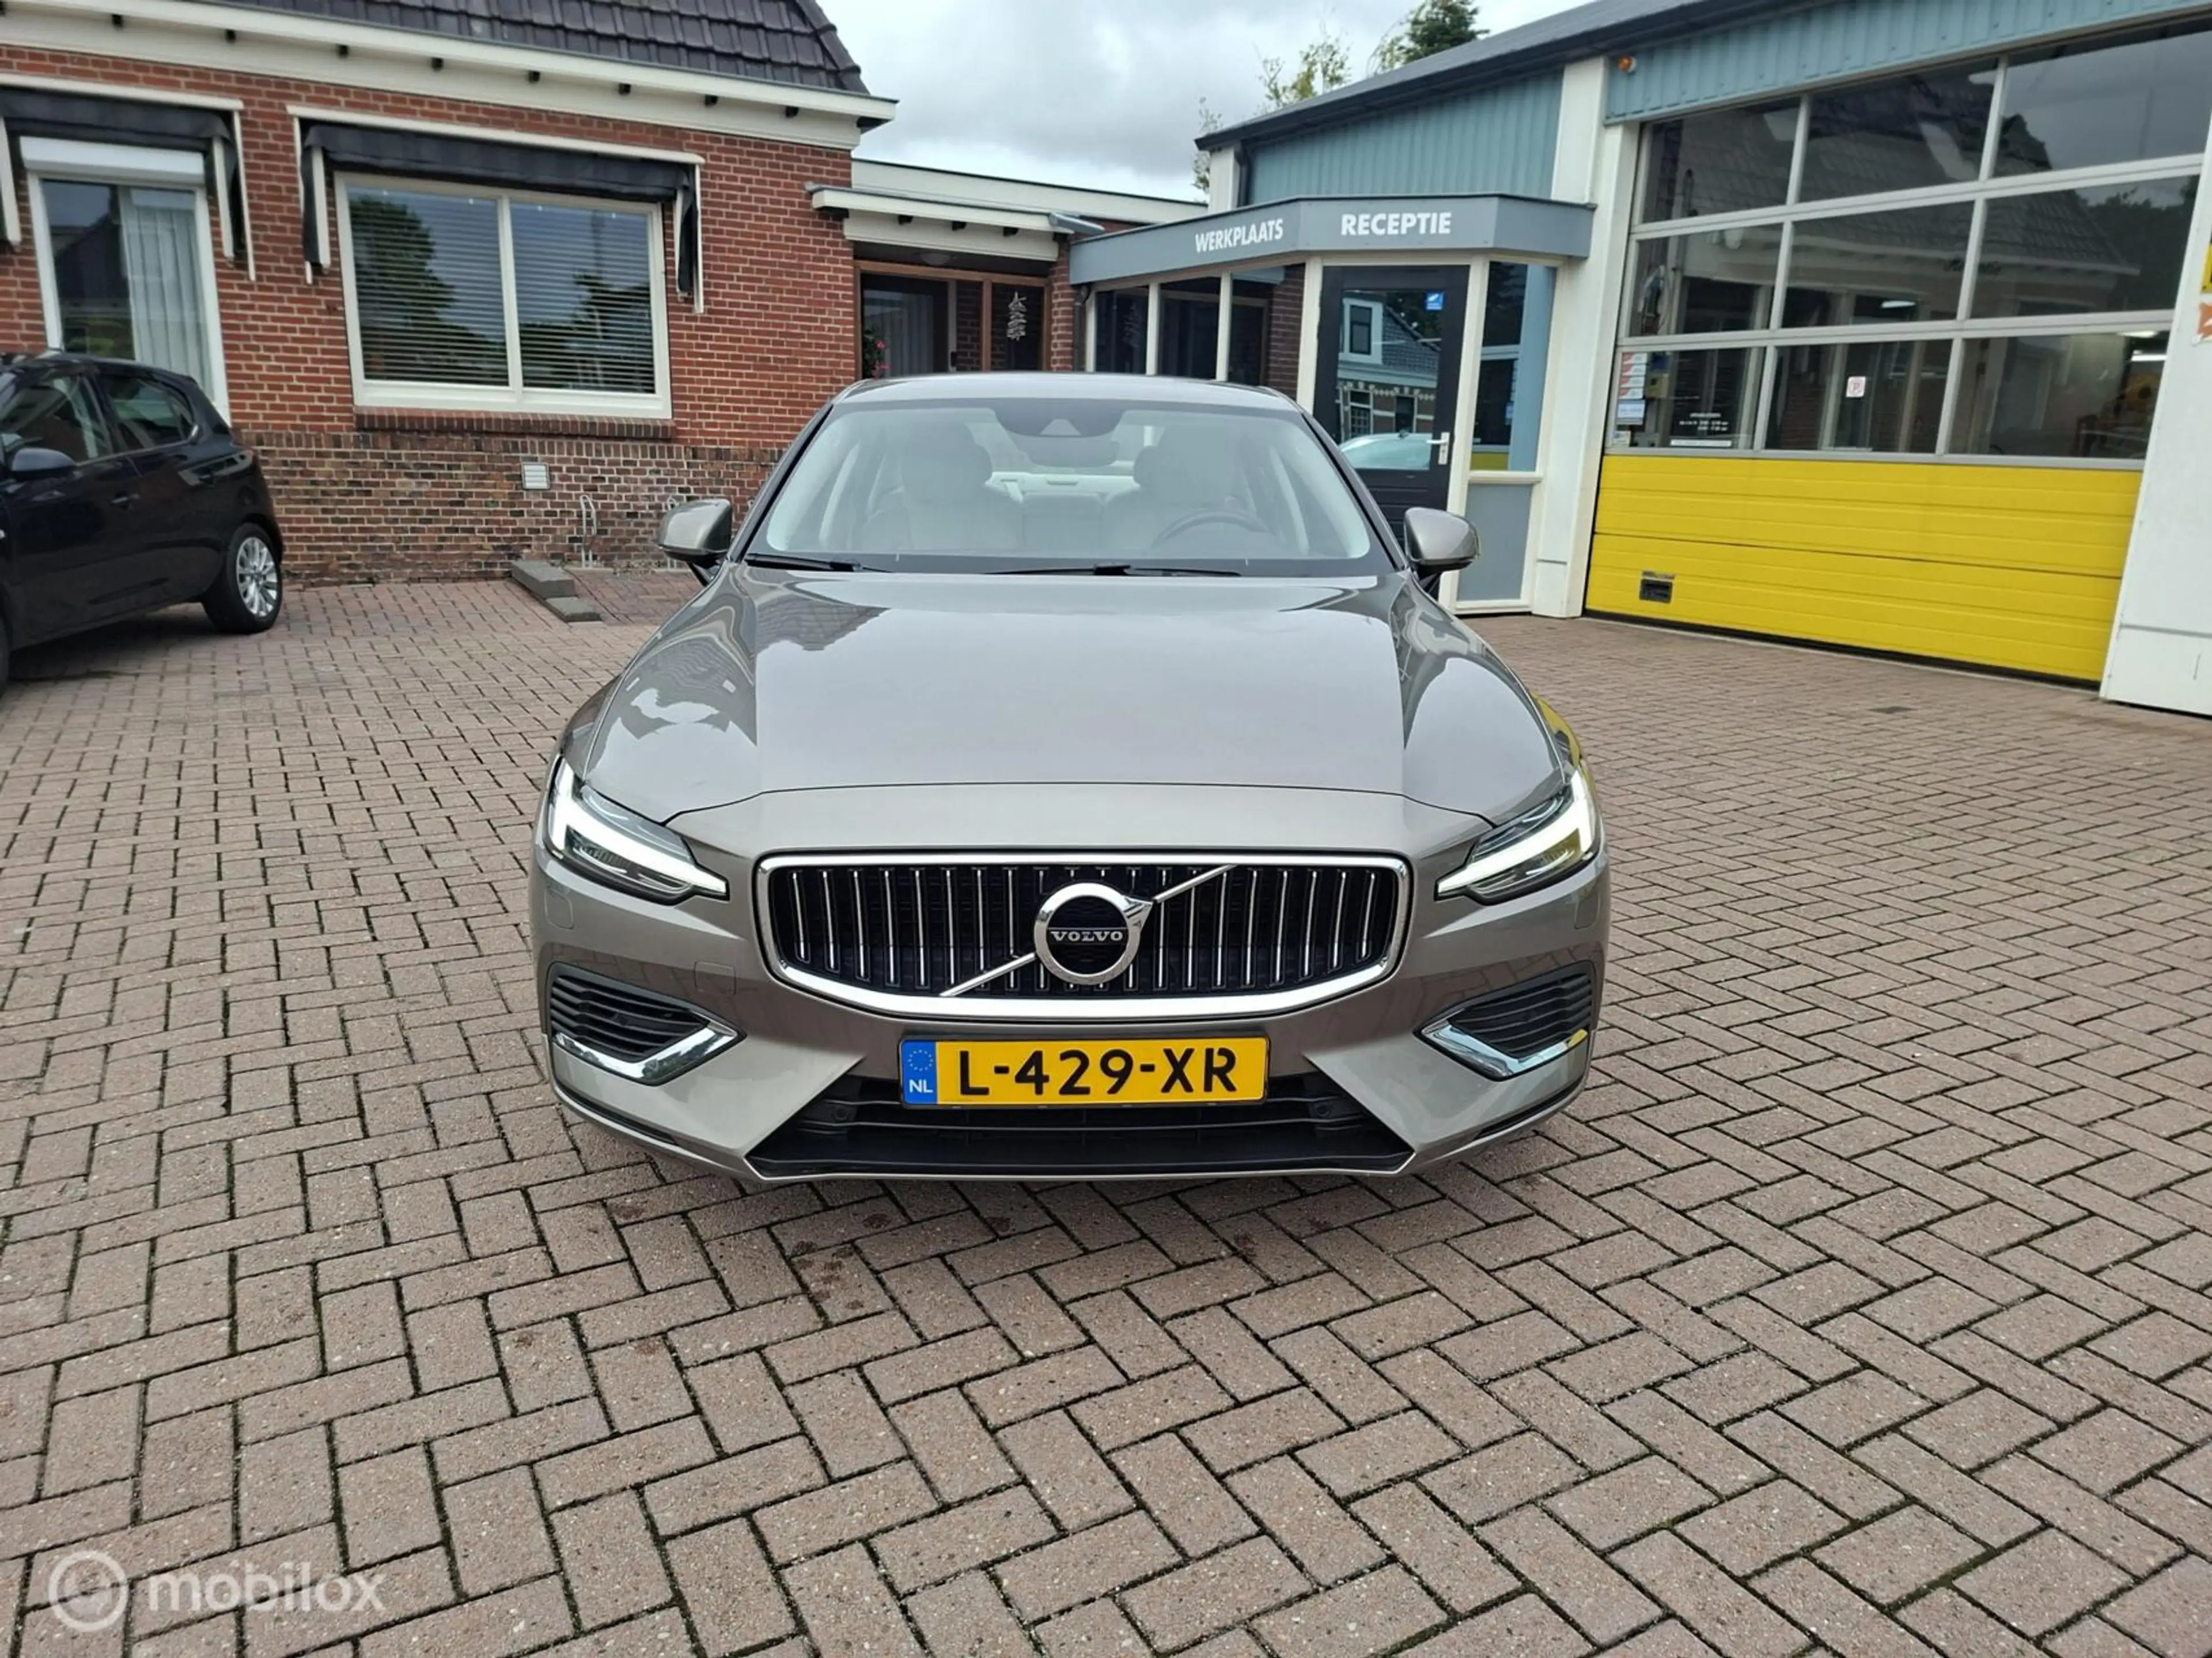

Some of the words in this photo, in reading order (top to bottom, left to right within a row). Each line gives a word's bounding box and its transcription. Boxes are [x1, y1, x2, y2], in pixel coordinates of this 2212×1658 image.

[1195, 219, 1283, 253] WERKPLAATS
[1340, 213, 1452, 236] RECEPTIE
[1051, 931, 1123, 942] VOLVO
[909, 1079, 934, 1094] NL
[959, 1047, 1237, 1096] L-429-XR
